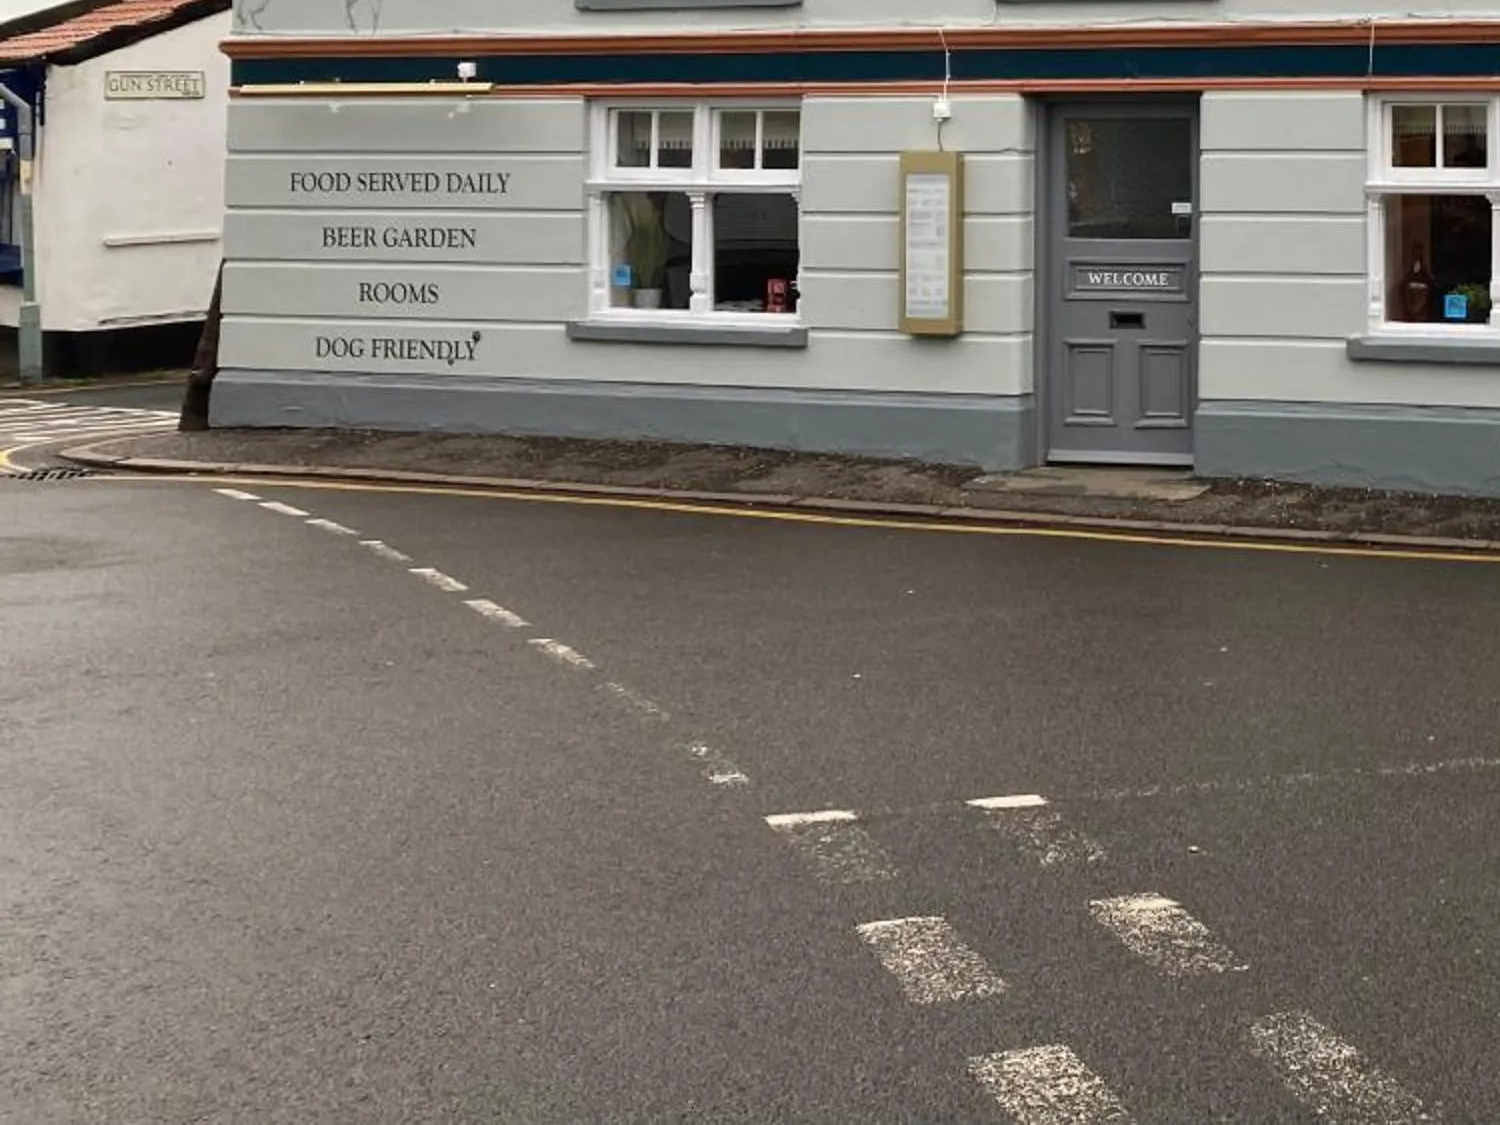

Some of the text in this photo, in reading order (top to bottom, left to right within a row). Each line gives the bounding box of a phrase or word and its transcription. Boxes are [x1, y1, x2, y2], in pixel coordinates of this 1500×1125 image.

[146, 78, 200, 93] STREET
[290, 172, 511, 194] FOOD SERVED DAILY
[322, 227, 477, 249] BEER GARDEN
[1087, 271, 1169, 286] WELCOME
[358, 282, 440, 304] ROOMS
[315, 337, 478, 361] DOG FRIENDLY
